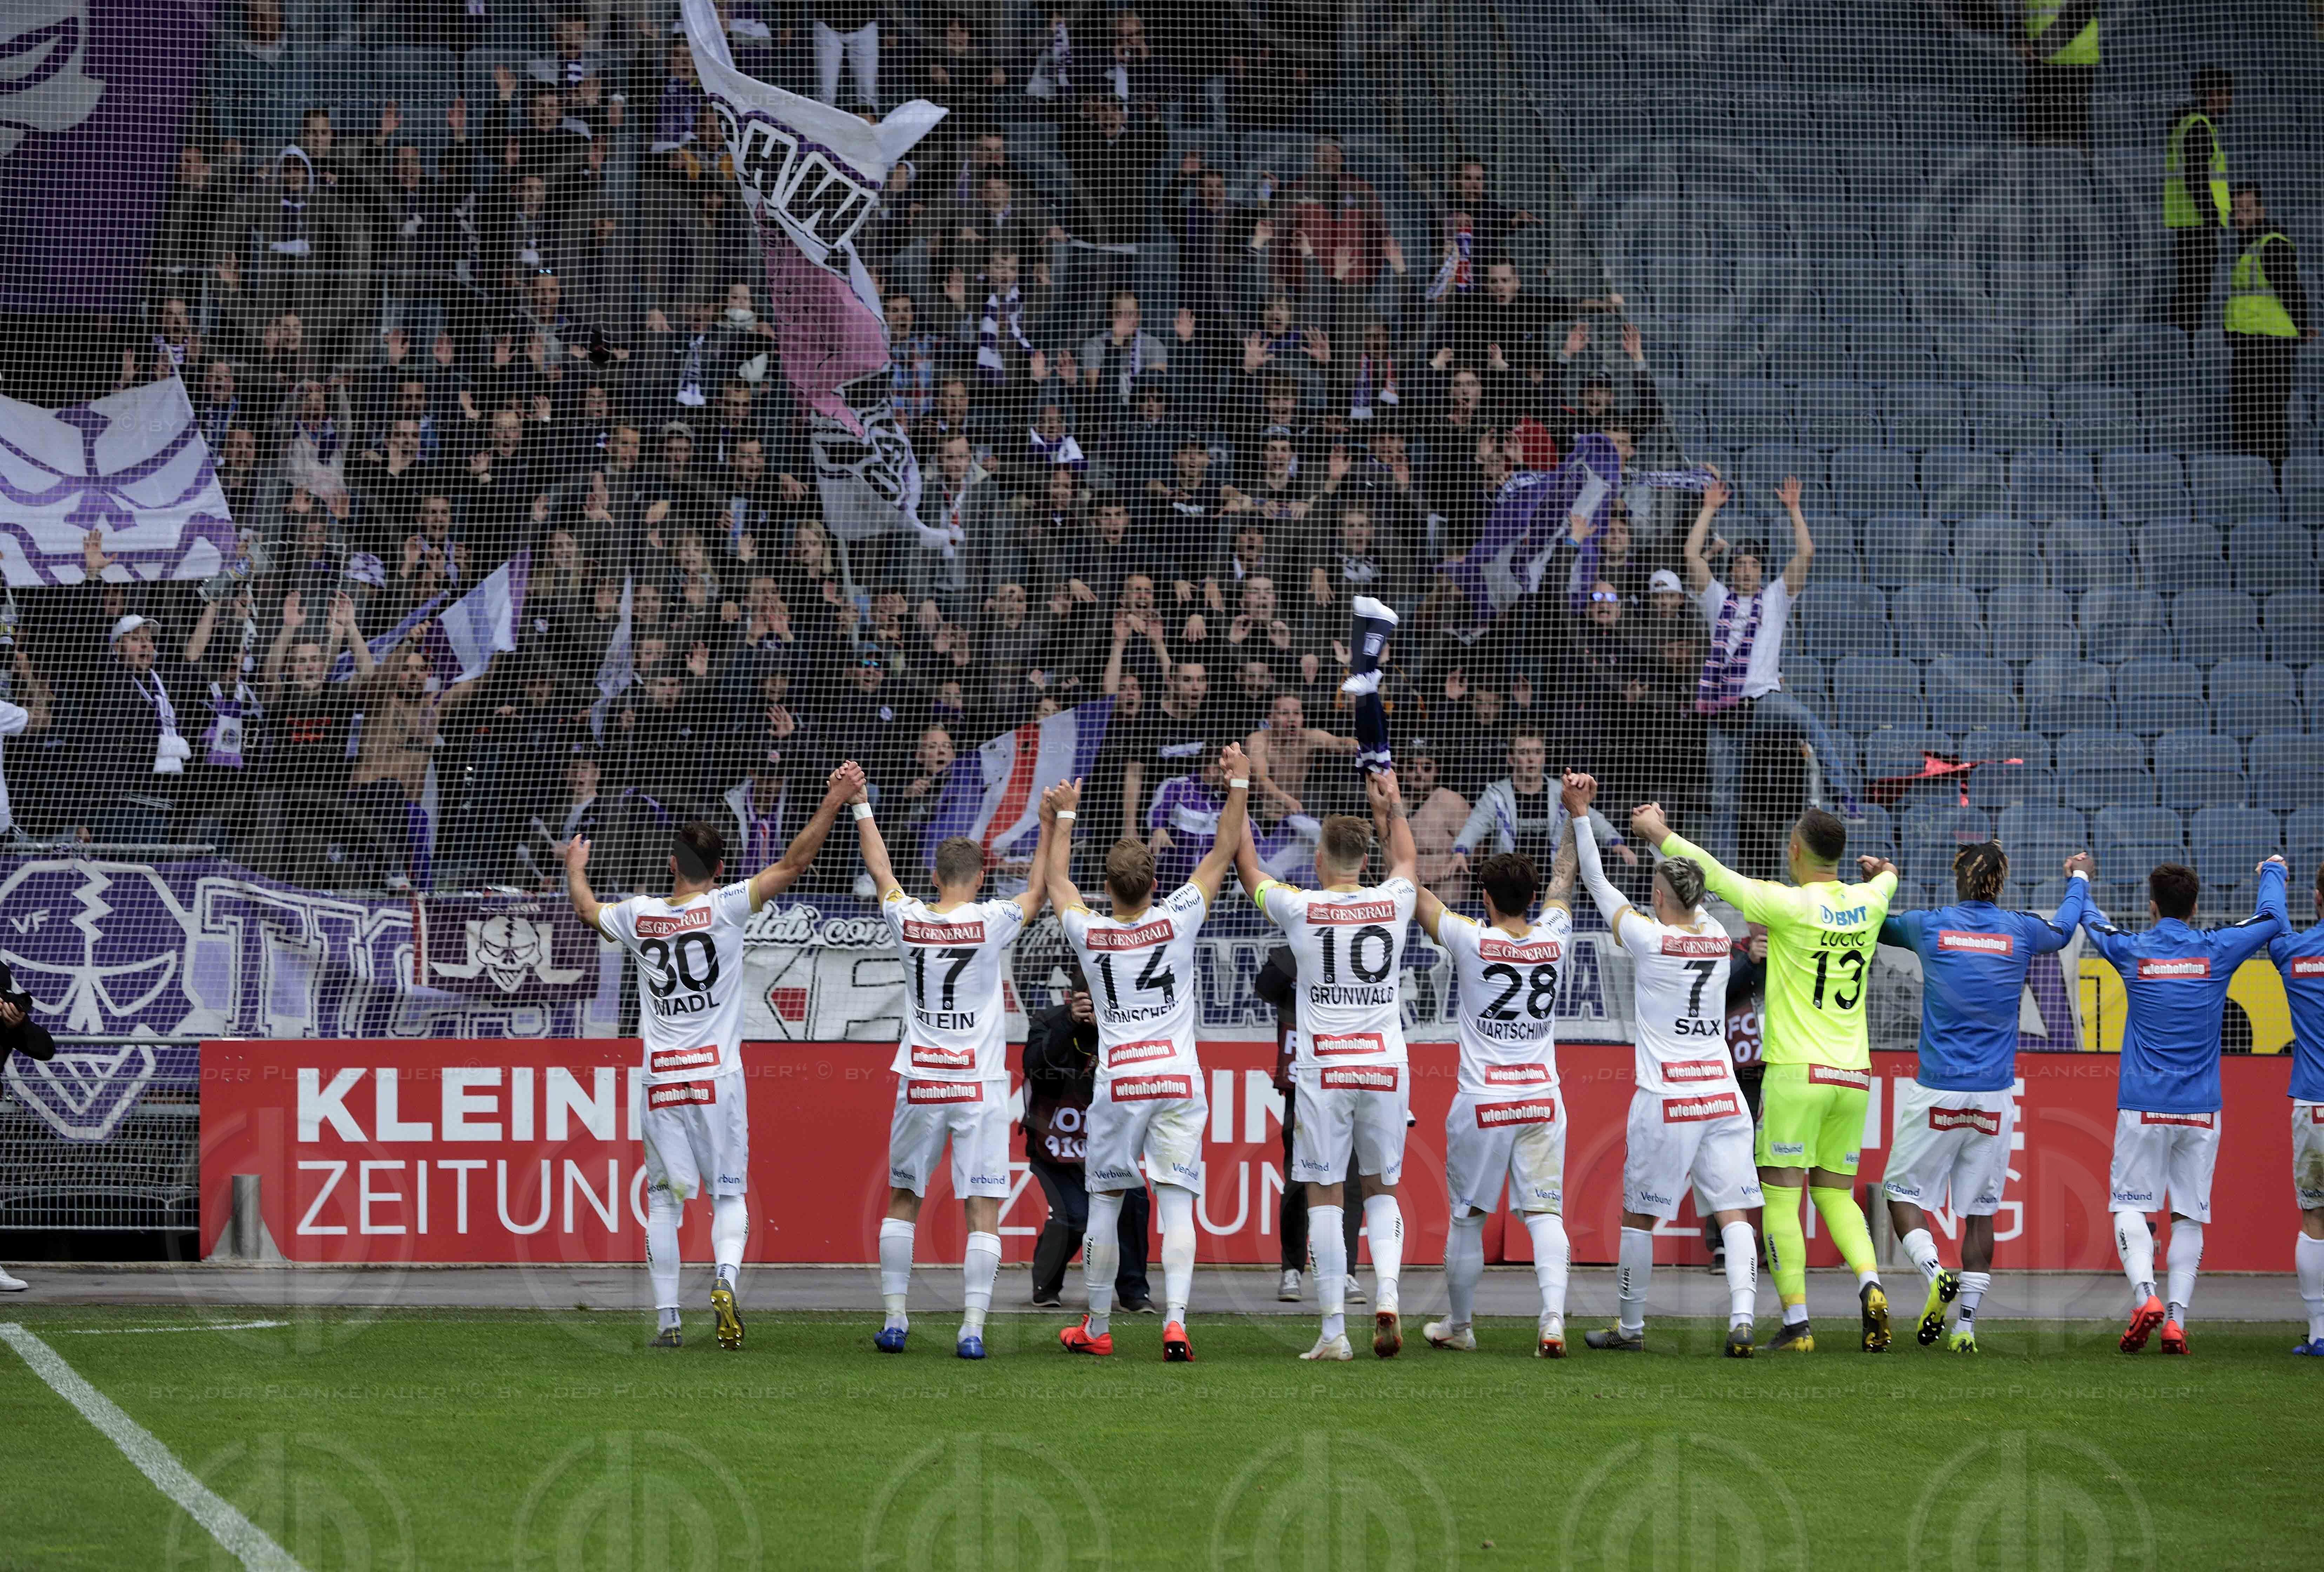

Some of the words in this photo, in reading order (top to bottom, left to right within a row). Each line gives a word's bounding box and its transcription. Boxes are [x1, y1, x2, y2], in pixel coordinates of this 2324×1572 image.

[1330, 904, 1395, 921] GENERALI
[1835, 906, 1866, 926] BNT
[921, 926, 982, 941] GENERALI
[1108, 924, 1169, 947] GENERALI
[1944, 935, 2007, 951] wienholding
[1313, 925, 1394, 983] 10
[1502, 945, 1558, 961] GENERALI
[641, 932, 719, 997] 30
[2143, 963, 2205, 975] wienholding
[909, 947, 979, 1010] 17
[1093, 945, 1175, 1009] 14
[1810, 950, 1866, 1010] 13
[1478, 963, 1558, 1021] 28
[1683, 960, 1717, 1018] 7
[654, 991, 720, 1016] MADL
[1674, 1018, 1721, 1036] SAX
[1316, 1038, 1379, 1051] wienholding
[1111, 1045, 1170, 1063] wienholding
[1115, 1080, 1187, 1096] wienholding
[1324, 1071, 1394, 1088] wienholding
[297, 1067, 642, 1142] KLEIN
[1668, 1099, 1735, 1118] wienholding
[1481, 1105, 1551, 1123] wienholding
[970, 1174, 1005, 1185] erbund
[1095, 1169, 1133, 1180] Verbund
